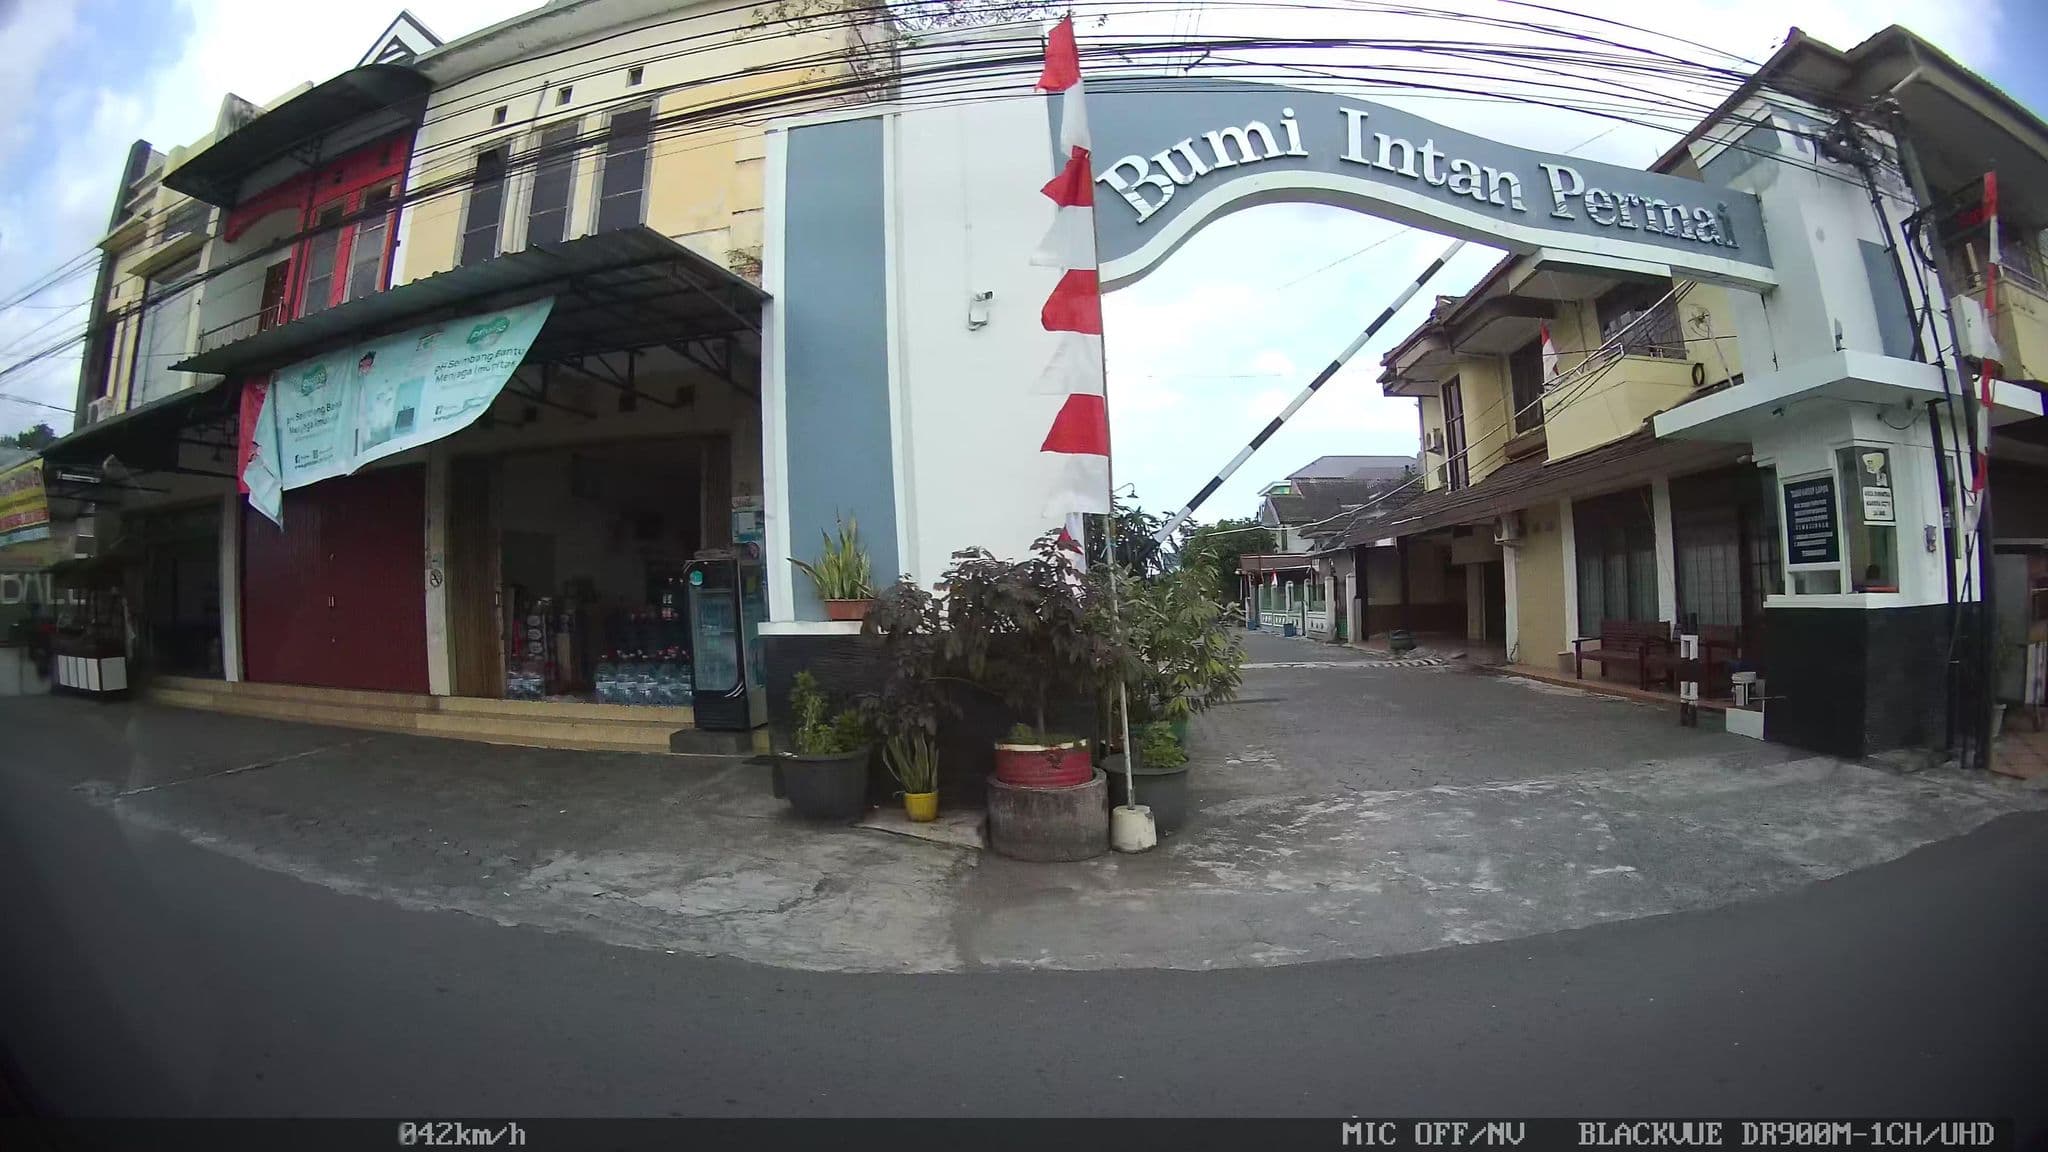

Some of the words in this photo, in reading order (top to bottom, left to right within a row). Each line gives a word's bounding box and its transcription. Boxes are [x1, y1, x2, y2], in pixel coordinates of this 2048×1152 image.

[1095, 107, 1308, 224] Bumi
[1339, 106, 1527, 212] Intan
[1538, 163, 1740, 249] Permai
